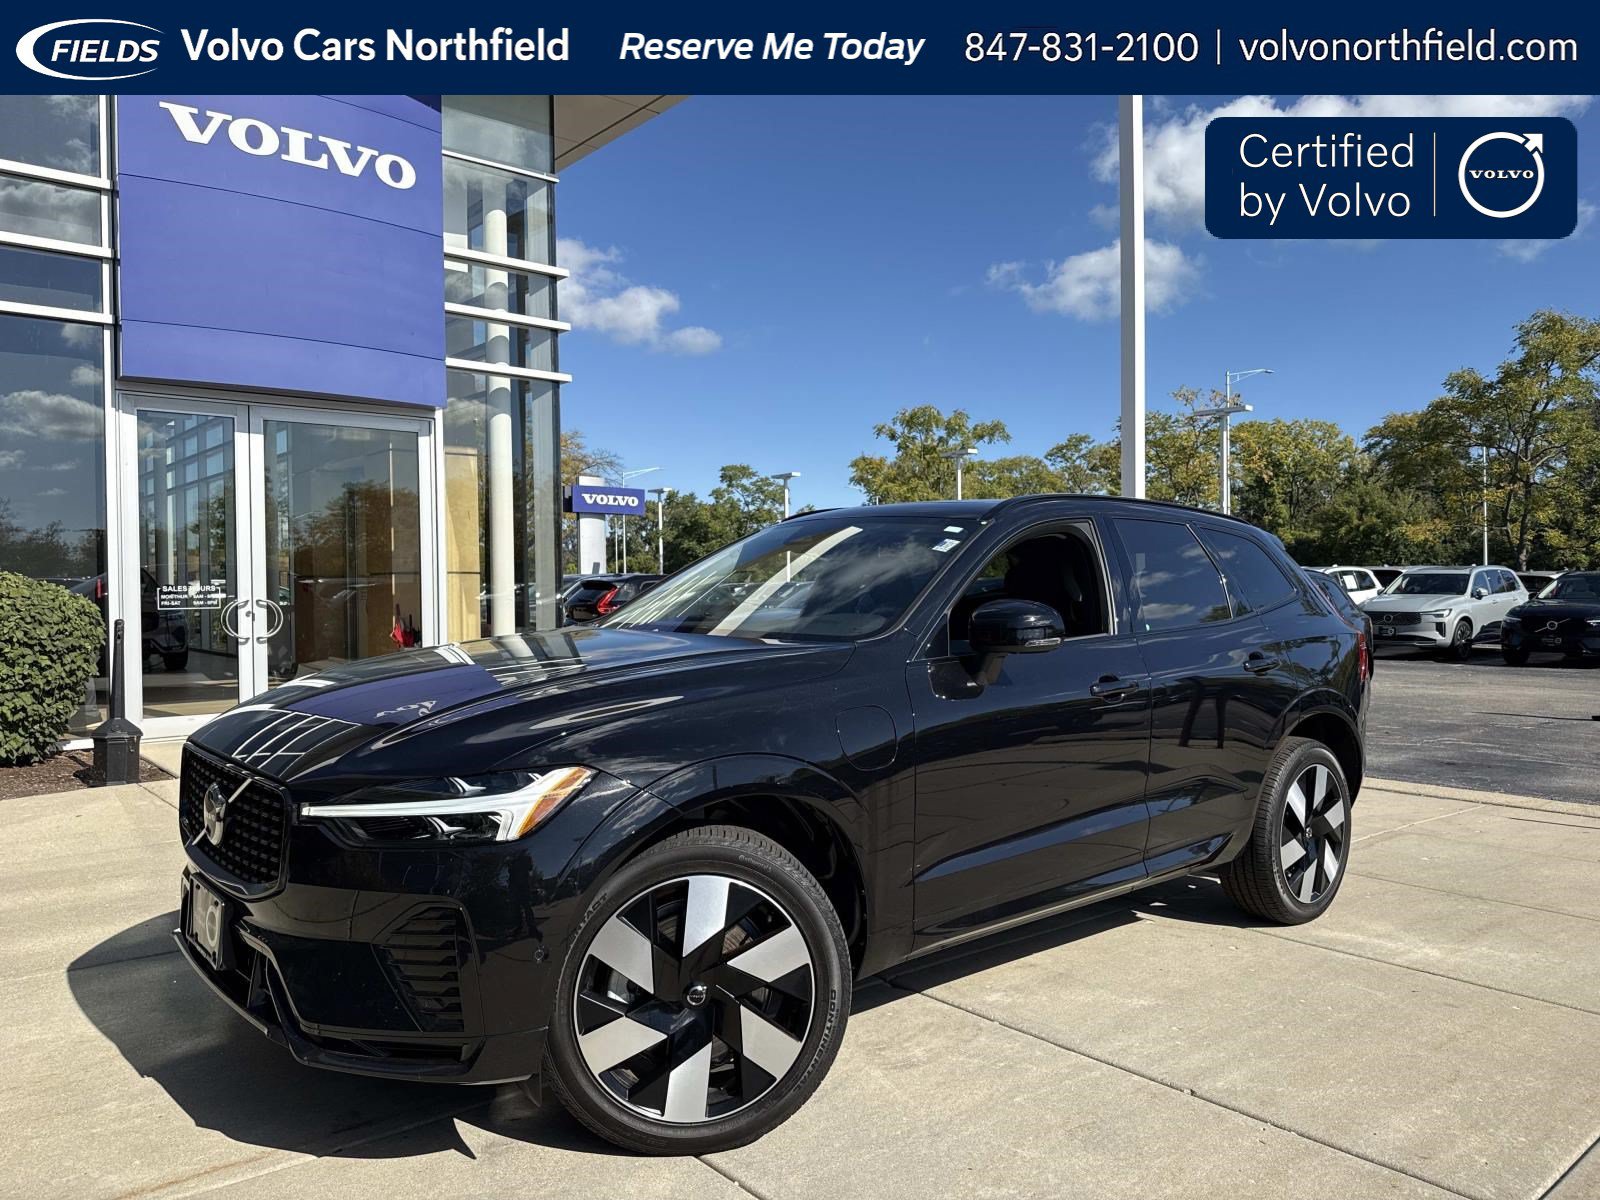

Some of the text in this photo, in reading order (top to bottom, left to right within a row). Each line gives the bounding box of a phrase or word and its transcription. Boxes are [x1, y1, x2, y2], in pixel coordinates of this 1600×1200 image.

[159, 101, 417, 190] VOLVO
[581, 493, 639, 507] VOLVO
[793, 988, 837, 1093] CONTINENTAL
